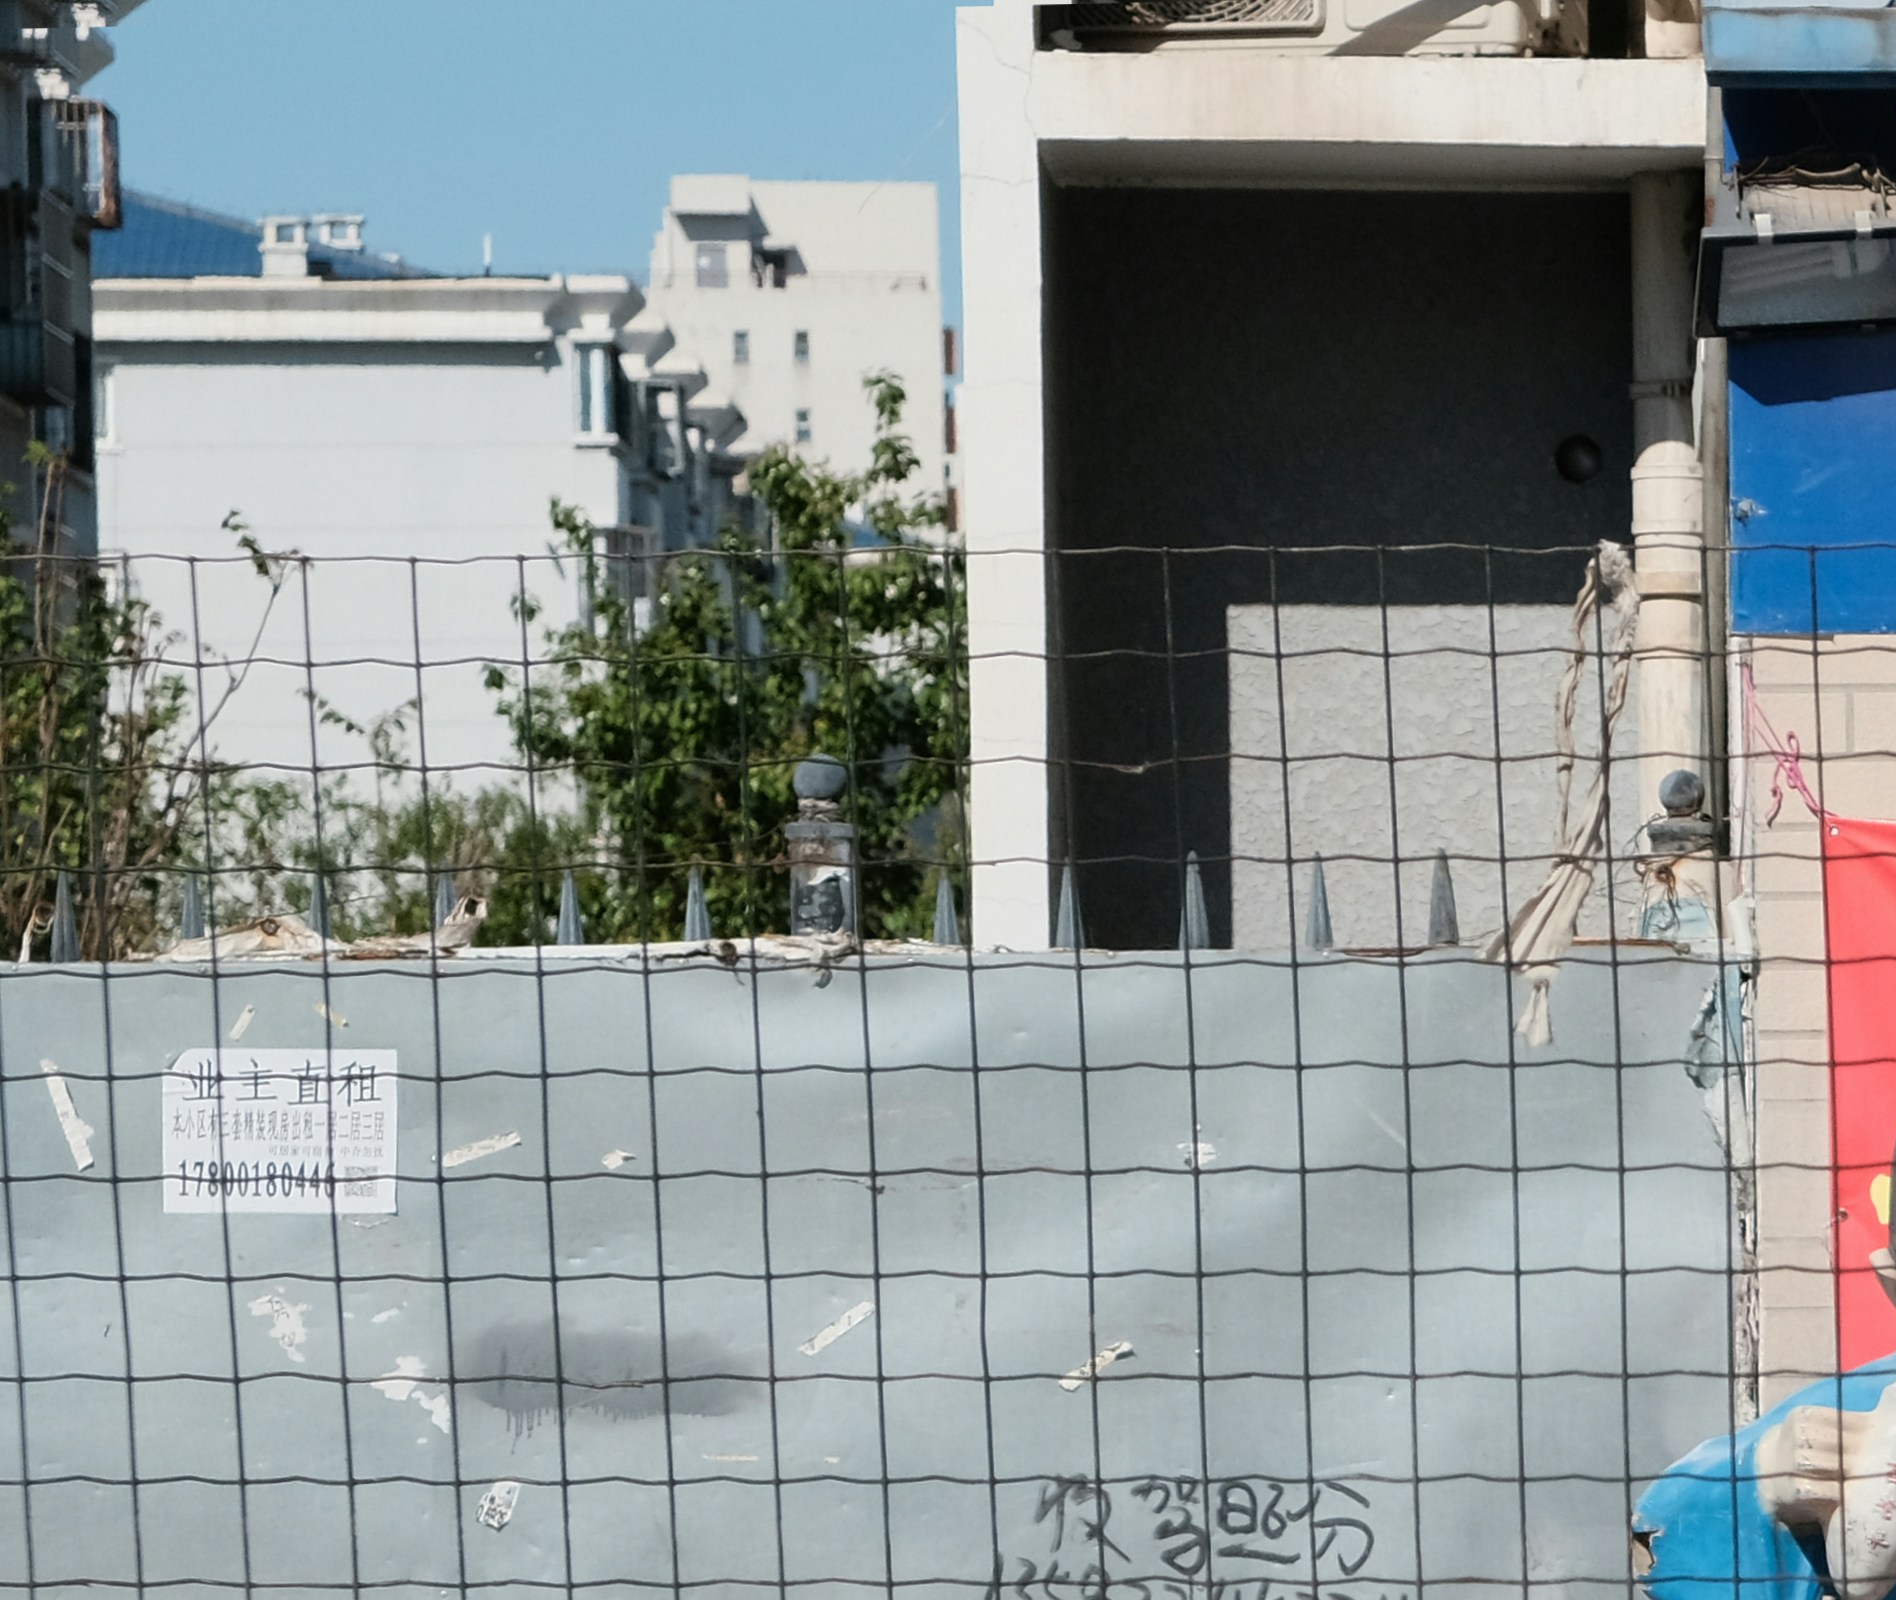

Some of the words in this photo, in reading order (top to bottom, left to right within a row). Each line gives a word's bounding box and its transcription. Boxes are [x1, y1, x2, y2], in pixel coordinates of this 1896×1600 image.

[181, 1057, 382, 1107] 业主直租
[177, 1159, 336, 1199] 17800180446
